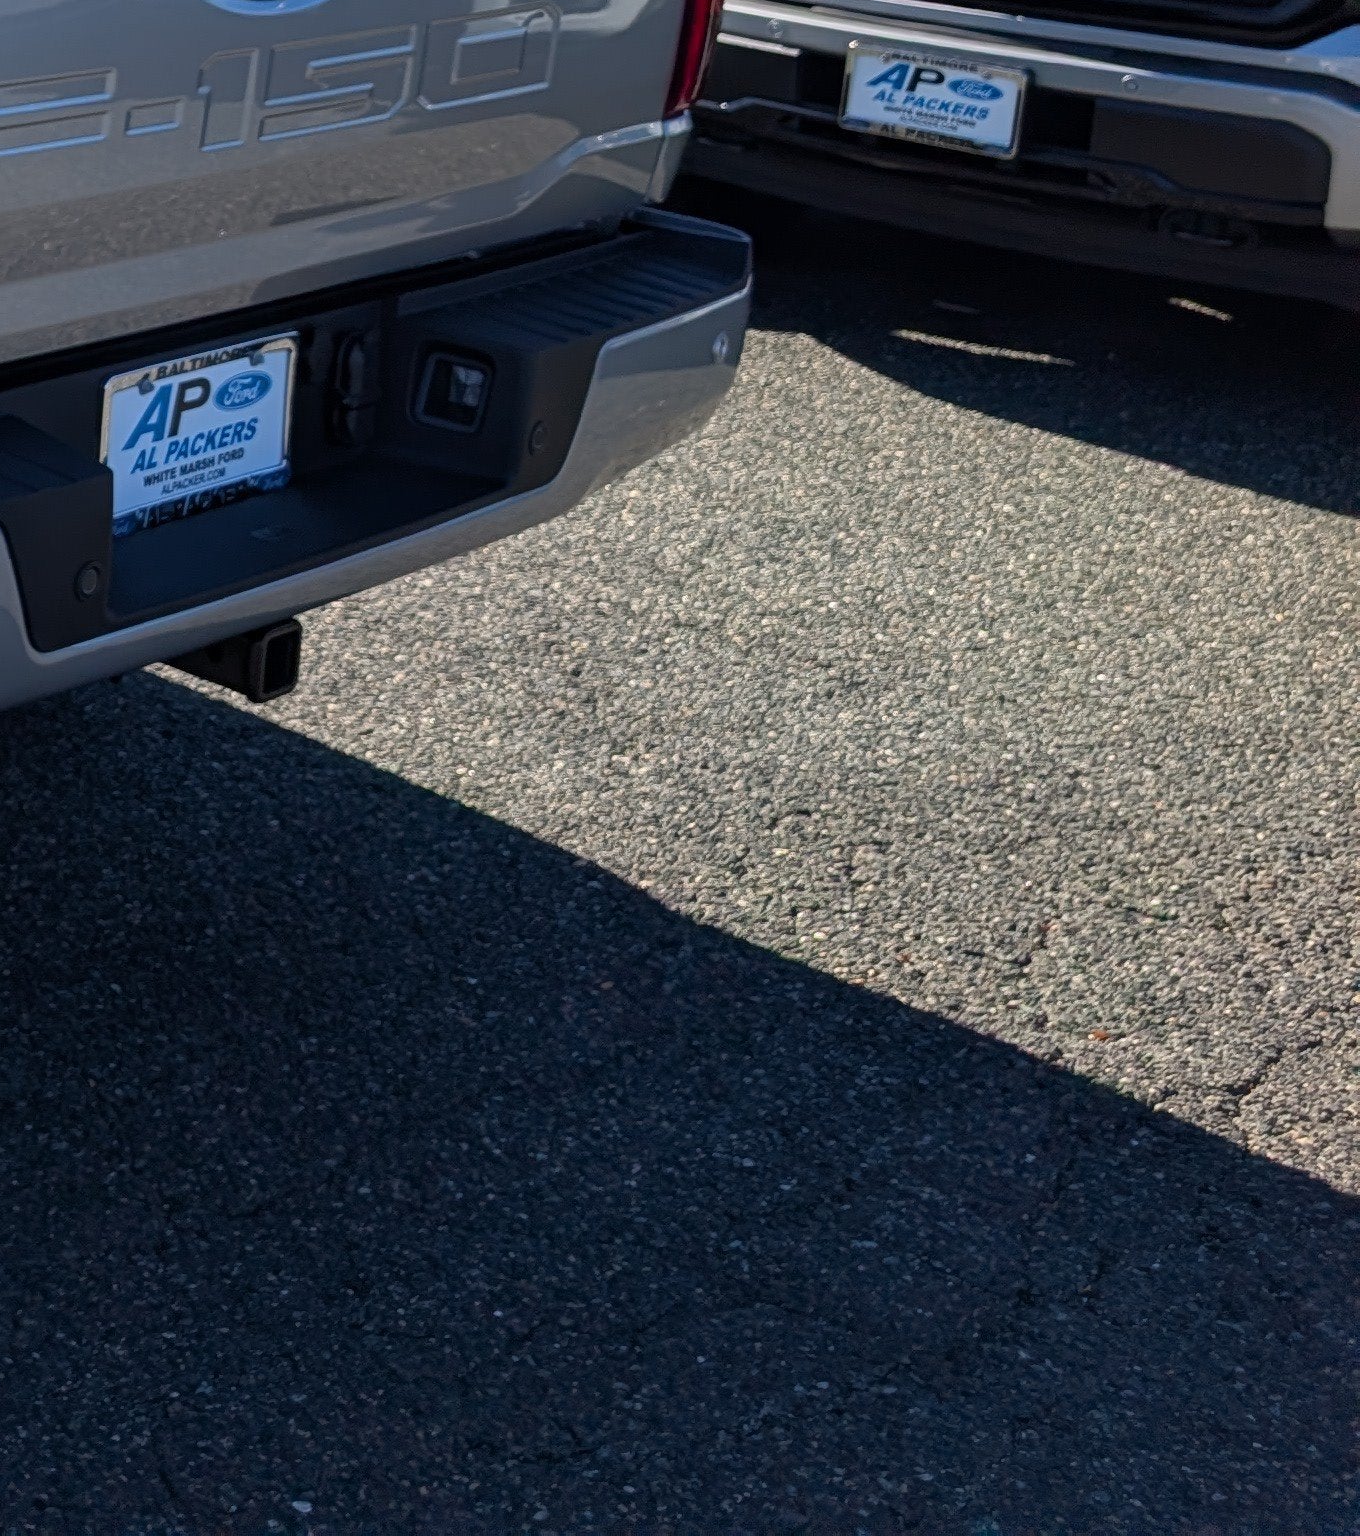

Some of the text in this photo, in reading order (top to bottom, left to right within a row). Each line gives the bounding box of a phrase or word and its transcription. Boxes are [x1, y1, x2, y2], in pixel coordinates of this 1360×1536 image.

[866, 62, 945, 94] AP
[872, 89, 989, 122] AL PACKERS
[121, 376, 263, 452] AP Ford
[131, 417, 258, 474] AL PACKERS
[143, 447, 244, 488] WHITE MARSH FORD
[161, 467, 226, 495] ALPACKER.COM
